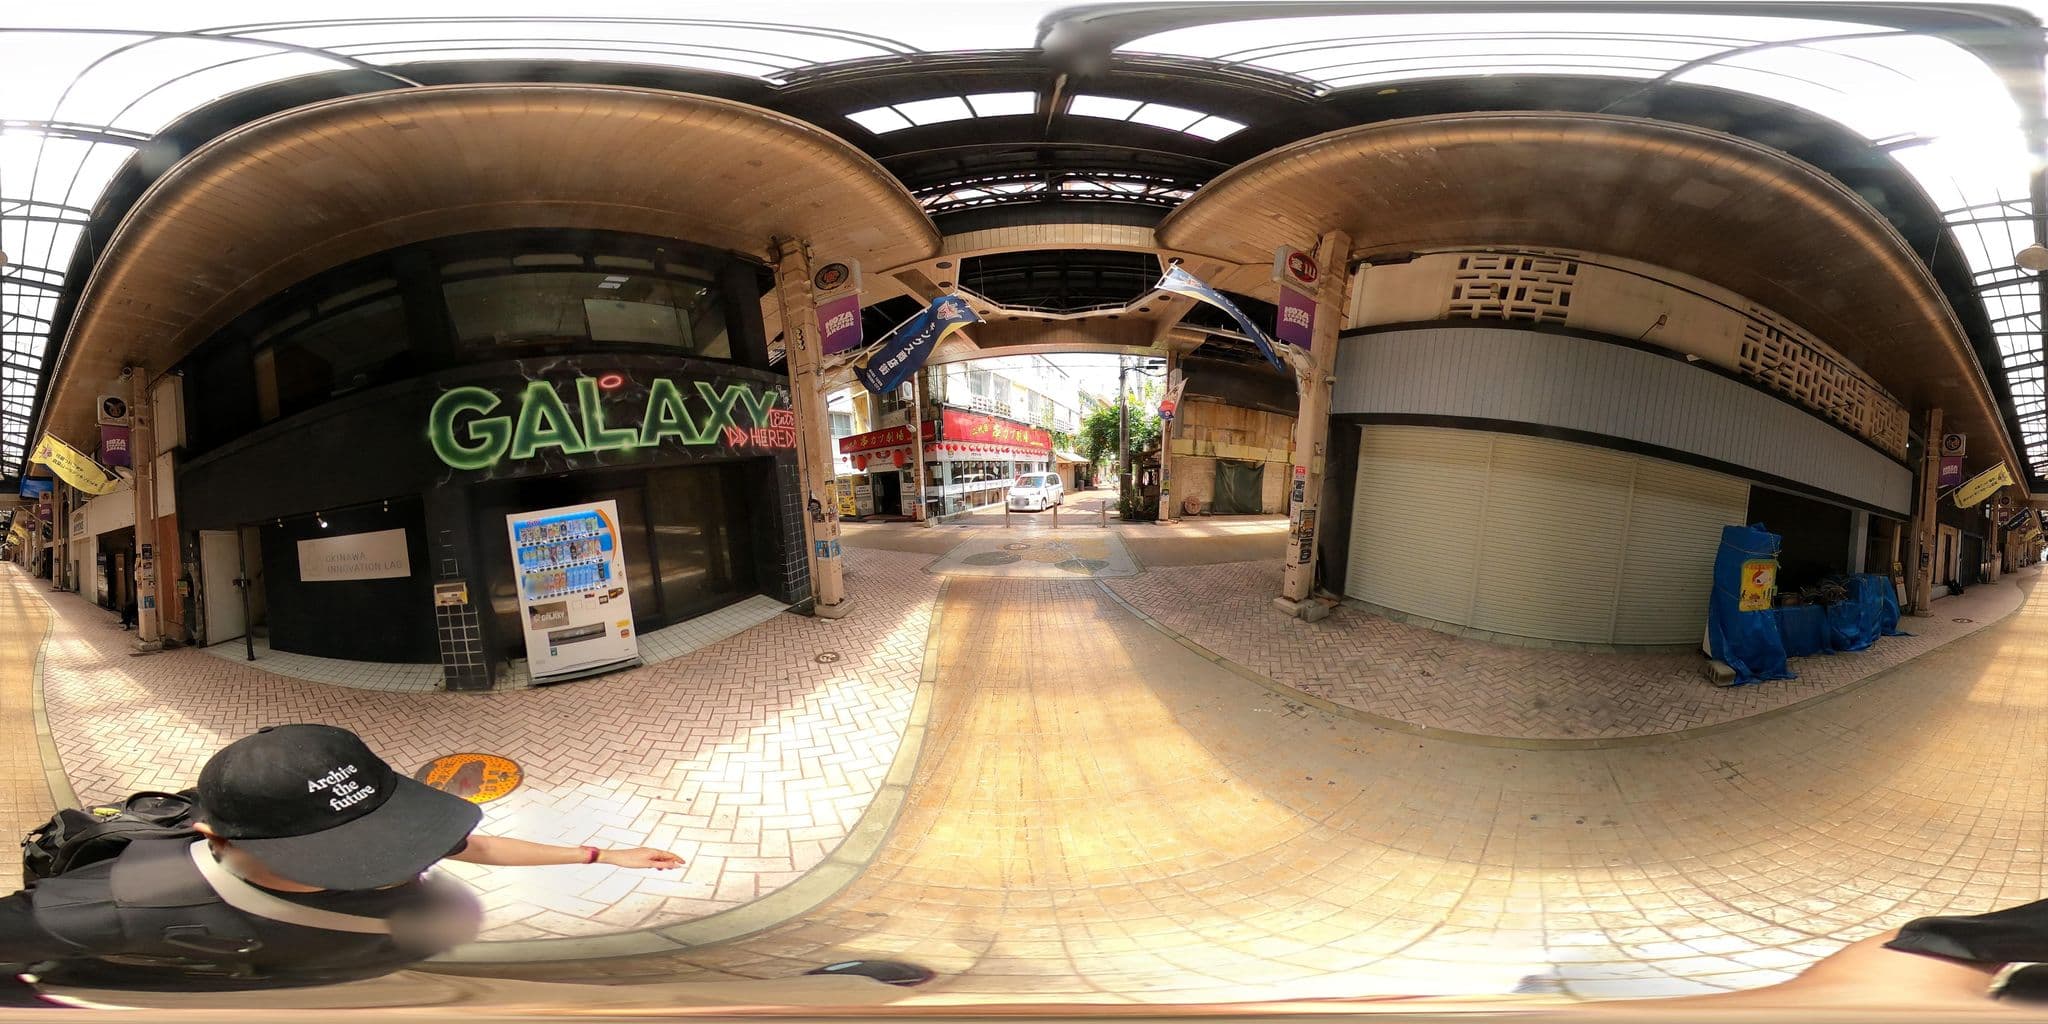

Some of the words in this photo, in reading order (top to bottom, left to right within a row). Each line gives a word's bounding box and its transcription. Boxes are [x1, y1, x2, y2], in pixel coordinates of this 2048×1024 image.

[878, 321, 936, 376] キングス商店街
[429, 377, 778, 470] GALAXY
[326, 551, 366, 562] OKINAWA
[327, 560, 381, 574] INNOVATION
[384, 559, 403, 570] LAB
[307, 764, 358, 793] Archive
[332, 780, 359, 797] the
[329, 785, 376, 811] future
